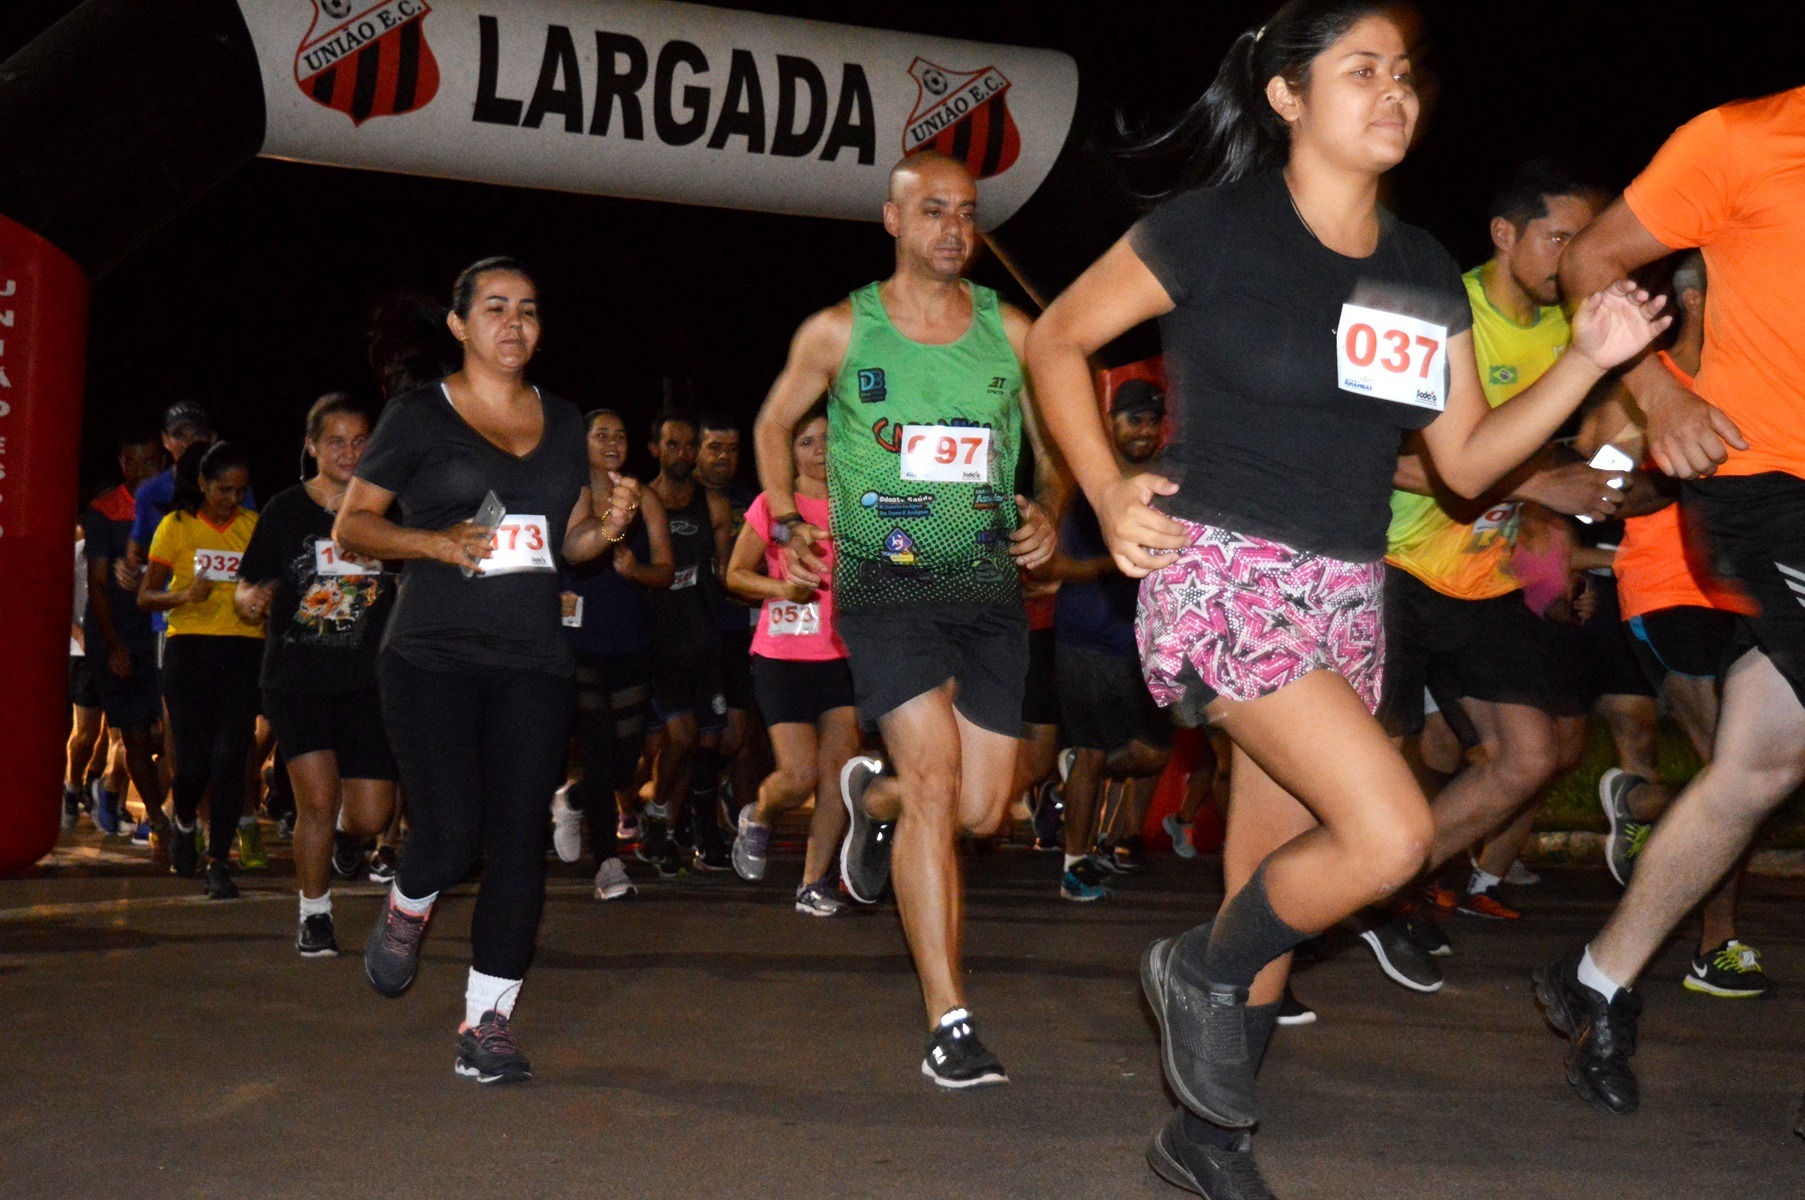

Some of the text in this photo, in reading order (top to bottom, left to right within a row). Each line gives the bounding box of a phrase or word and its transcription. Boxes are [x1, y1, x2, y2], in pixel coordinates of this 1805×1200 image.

[303, 21, 376, 71] UNIÃO
[472, 14, 876, 166] LARGADA
[910, 76, 1004, 143] UNIÃO E.C.
[1345, 323, 1439, 379] 037
[198, 554, 240, 572] 032
